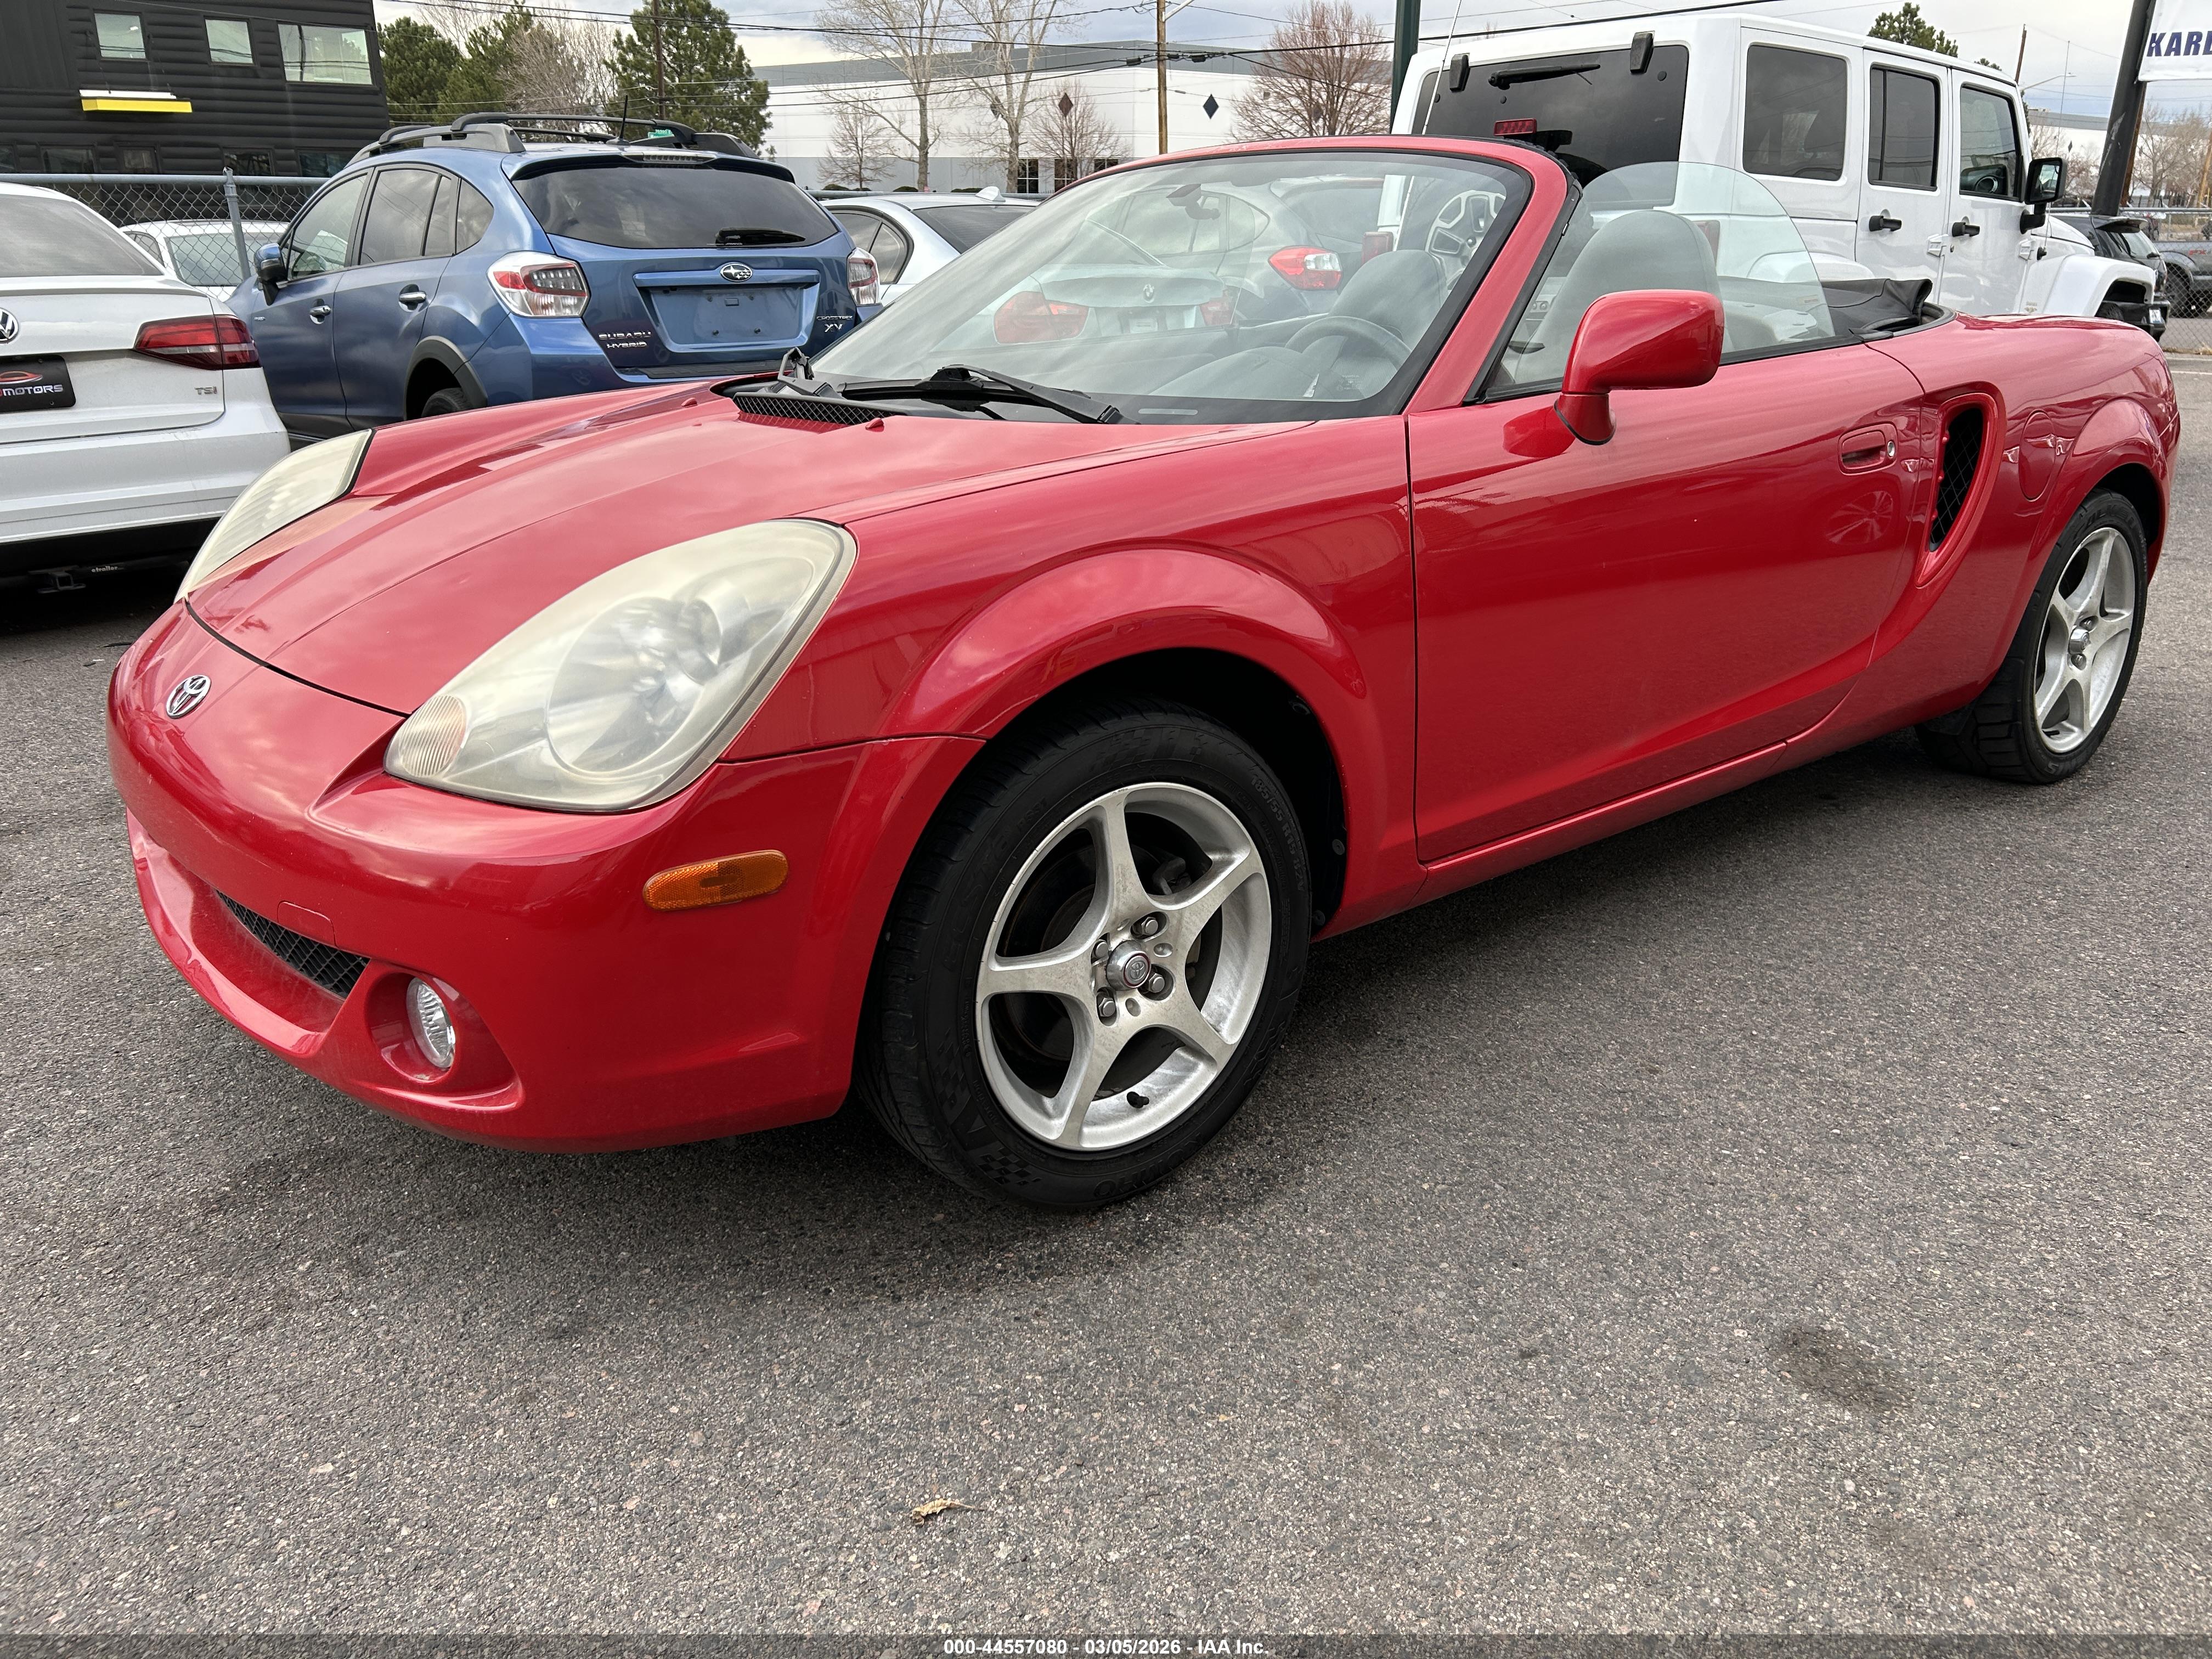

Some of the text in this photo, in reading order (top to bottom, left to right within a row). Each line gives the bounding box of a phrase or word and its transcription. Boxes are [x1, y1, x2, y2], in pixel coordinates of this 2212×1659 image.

[824, 323, 843, 332] XV
[598, 331, 652, 340] SUBARU
[0, 384, 64, 397] MOTORS
